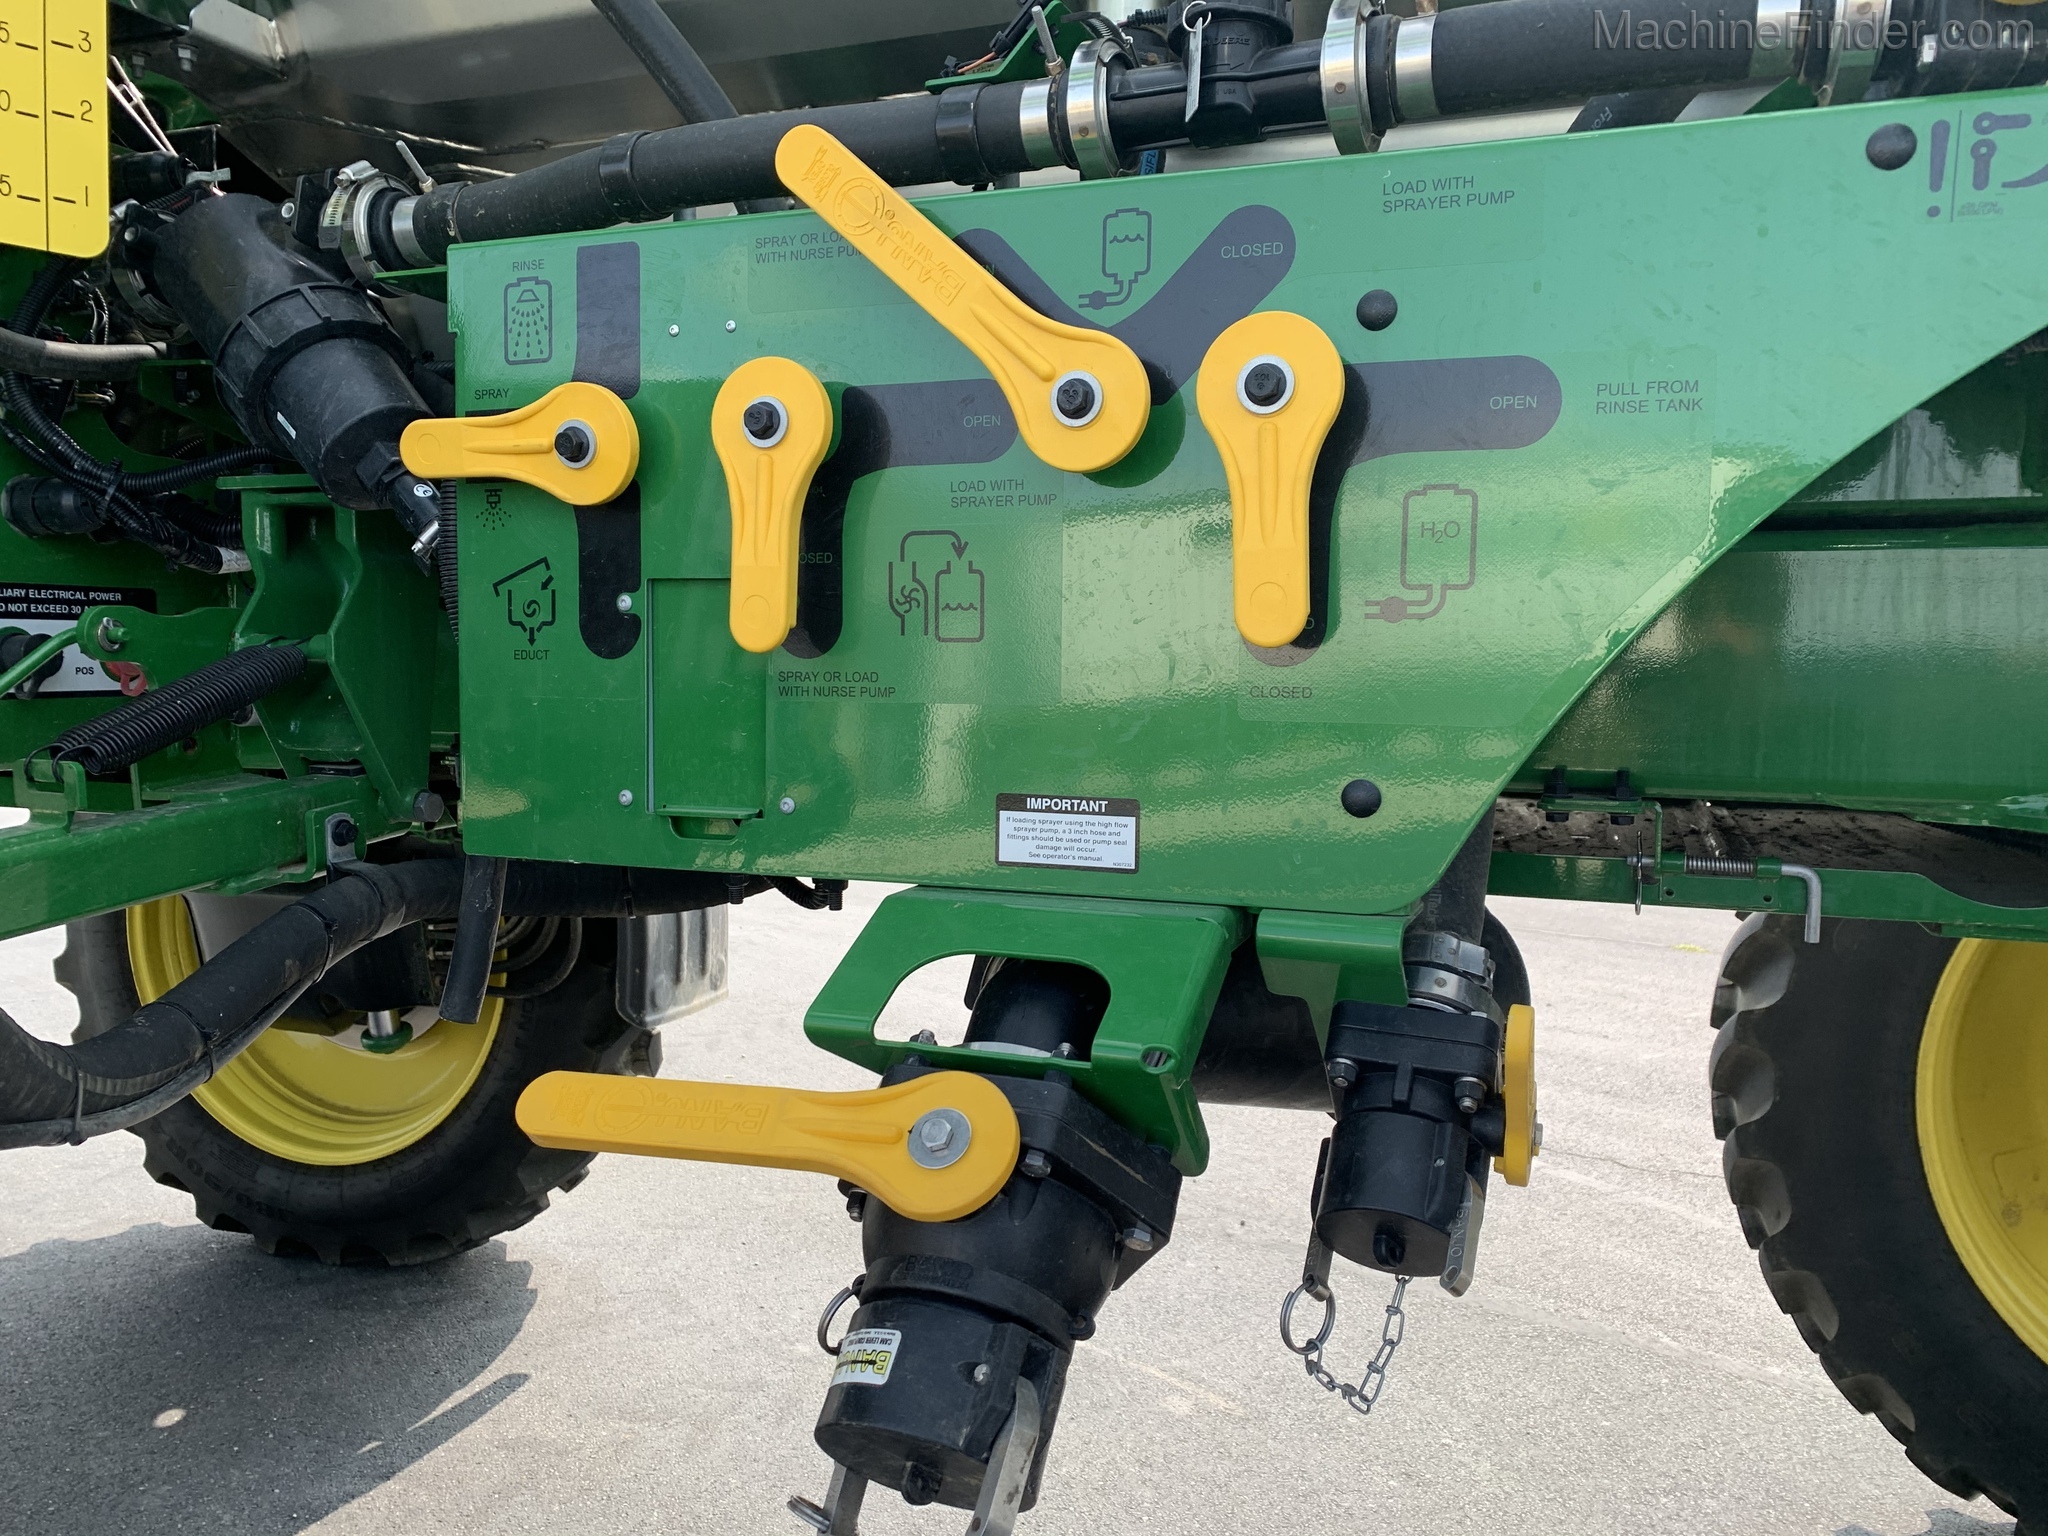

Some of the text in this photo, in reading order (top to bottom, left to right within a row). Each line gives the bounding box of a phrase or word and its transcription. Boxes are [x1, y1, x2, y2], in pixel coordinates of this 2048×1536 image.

[78, 29, 92, 53] 3
[80, 99, 94, 123] 2
[1381, 176, 1475, 197] LOAD WITH
[84, 185, 89, 207] 1
[1381, 190, 1516, 213] SPRAYER PUMP
[755, 230, 843, 249] SPRAY OR LO
[755, 245, 862, 264] WITH NURSE PU
[1220, 241, 1284, 259] CLOSED
[512, 259, 545, 272] RINSE
[474, 388, 510, 400] SPRAY
[1596, 379, 1700, 397] PULL FROM
[1489, 394, 1538, 410] OPEN
[1595, 397, 1704, 415] RINSE TANK
[962, 414, 1001, 428] OPEN
[950, 478, 1025, 493] LOAD WITH
[950, 493, 1058, 508] SPRAYER PUMP
[799, 552, 833, 564] OSED
[28, 589, 87, 600] ELECTRICAL
[88, 591, 122, 601] POWER
[7, 603, 28, 612] NOT
[30, 604, 69, 613] EXCEED
[70, 605, 82, 614] 30
[513, 649, 550, 660] EDUCT
[75, 666, 95, 676] POS
[777, 671, 879, 684] SPRAY OR LOAD
[777, 685, 896, 698] WITH NURSE PUMP
[1249, 685, 1313, 699] CLOSED
[1026, 797, 1109, 813] IMPORTANT
[1012, 817, 1037, 825] loading
[1038, 819, 1063, 827] sprayer
[1065, 820, 1084, 828] using
[1098, 821, 1113, 829] high
[1114, 821, 1129, 829] flow
[1013, 826, 1038, 834] sprayer
[1039, 827, 1061, 835] pump,
[1090, 829, 1107, 837] hose
[1007, 833, 1030, 842] fittings
[1031, 834, 1054, 842] should
[1055, 835, 1064, 843] be
[1065, 836, 1082, 844] used
[1092, 839, 1112, 847] pump
[1035, 844, 1062, 852] damage
[1042, 853, 1076, 861] operator's
[1077, 854, 1105, 862] manual.
